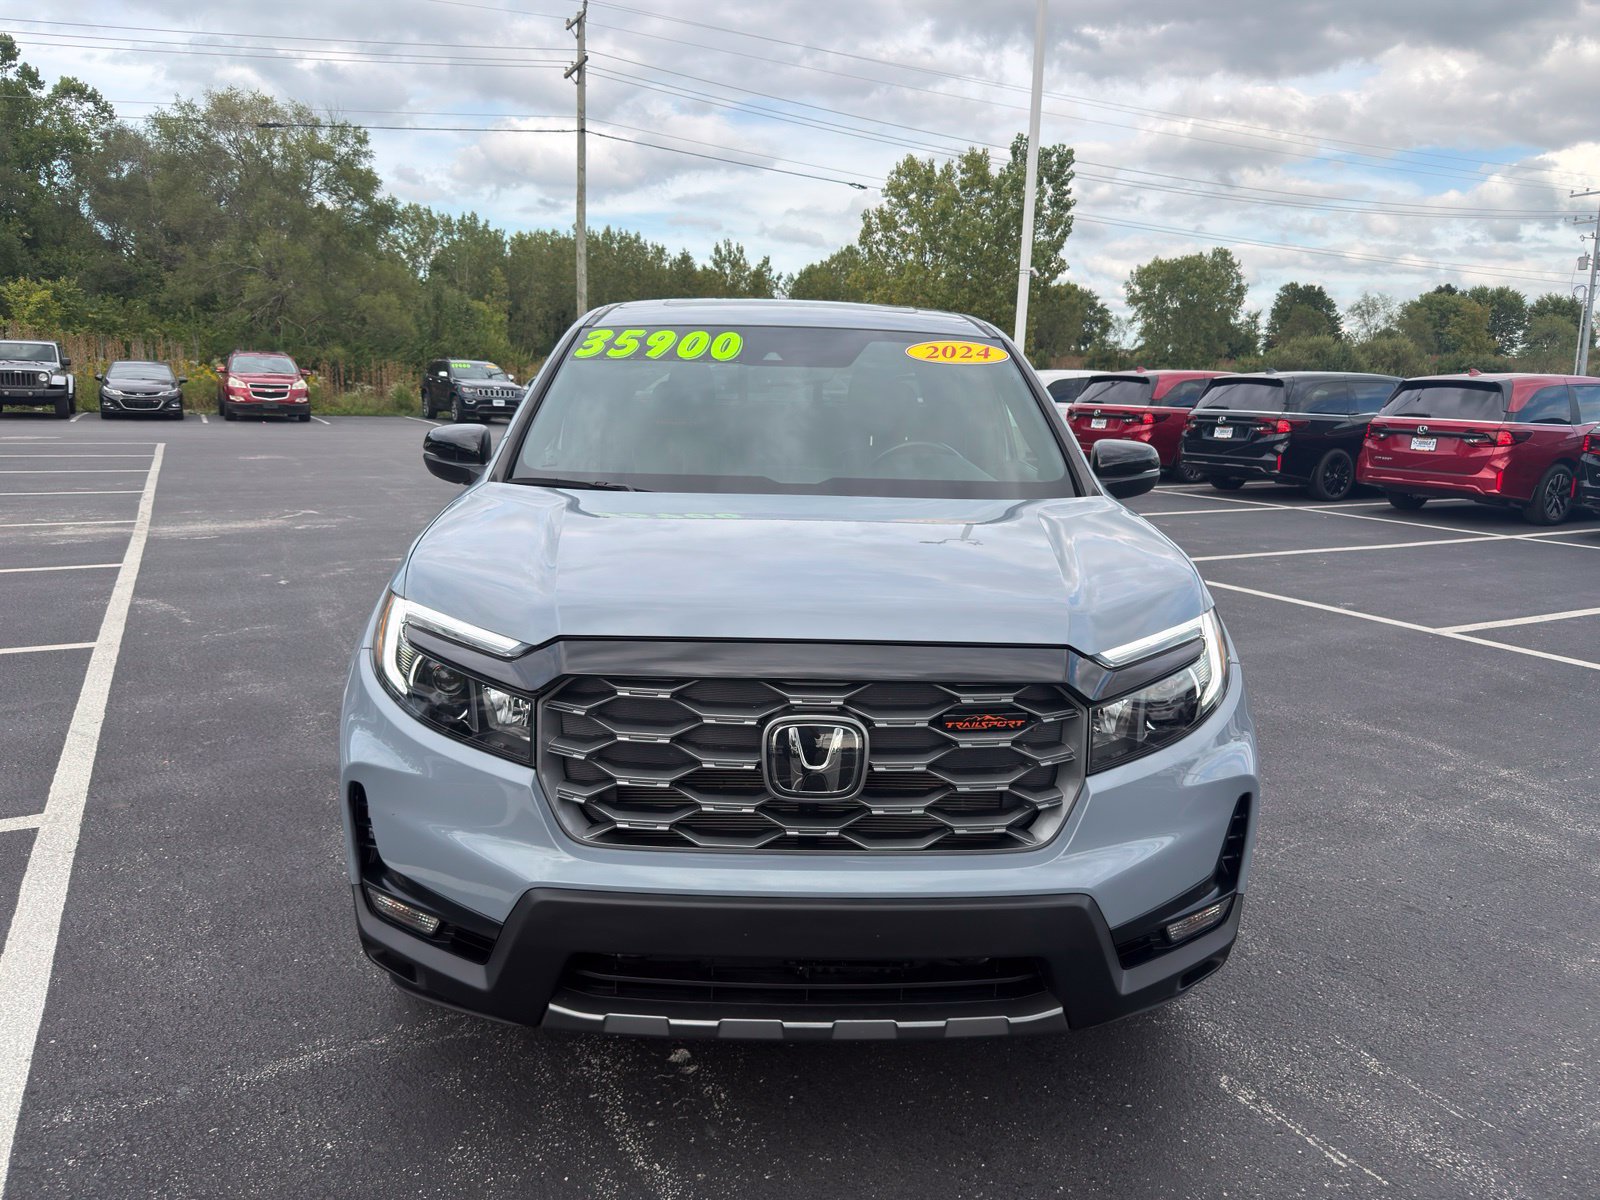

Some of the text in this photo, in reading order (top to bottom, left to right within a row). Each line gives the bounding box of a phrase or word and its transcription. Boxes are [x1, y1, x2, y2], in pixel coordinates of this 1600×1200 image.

[573, 329, 744, 362] 35900
[925, 345, 991, 359] 2024
[945, 719, 1026, 730] TRAILSPORT
